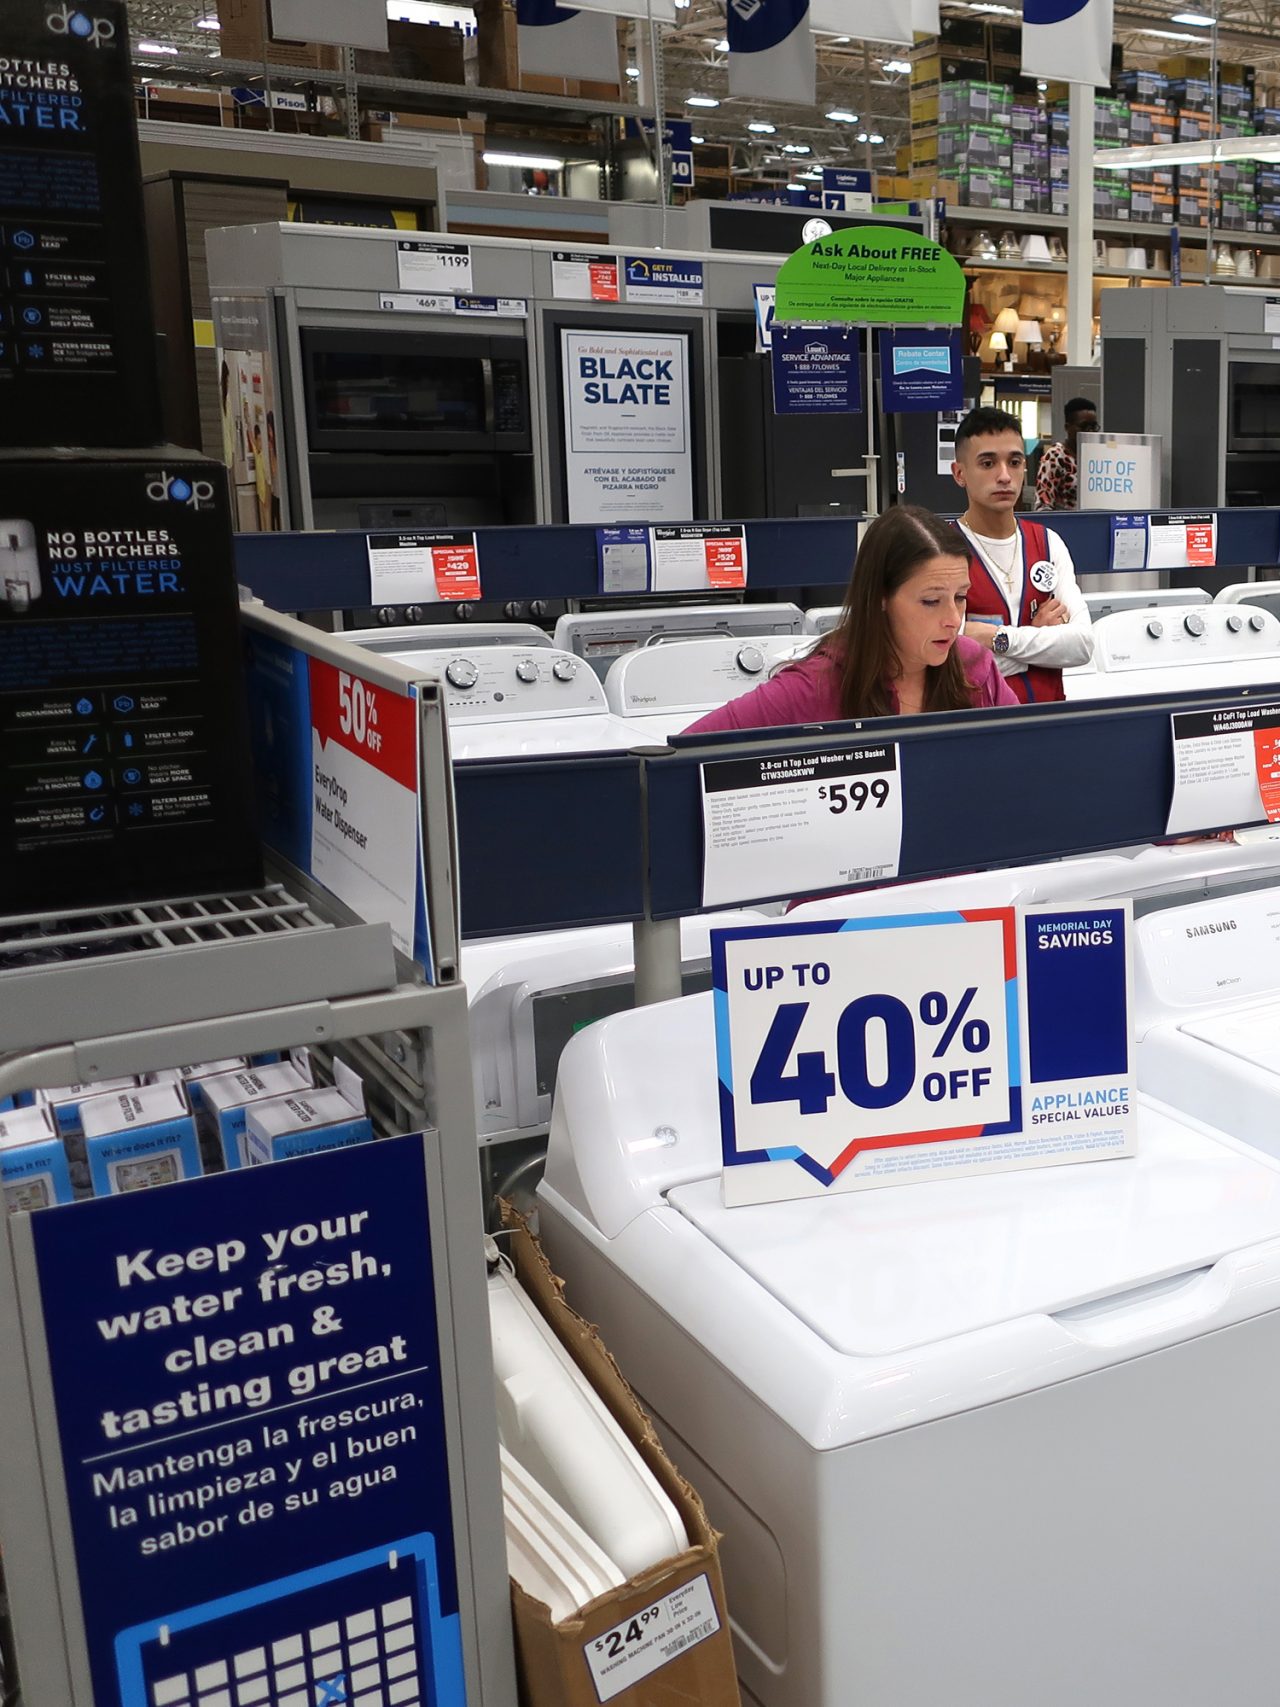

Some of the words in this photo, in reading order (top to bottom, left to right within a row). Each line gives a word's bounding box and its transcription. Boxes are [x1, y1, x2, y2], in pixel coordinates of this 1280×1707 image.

[1, 90, 82, 107] FILTERED
[277, 96, 306, 109] Pisos
[836, 175, 857, 183] Lighting
[811, 243, 844, 257] Ask
[847, 244, 897, 260] About
[901, 247, 941, 261] FREE
[812, 262, 846, 272] Next-Day
[847, 263, 867, 271] Local
[868, 263, 897, 273] Delivery
[652, 273, 702, 284] INSTALLED
[844, 273, 865, 283] Major
[866, 274, 904, 284] Appliances
[782, 354, 809, 362] SERVICE
[810, 354, 850, 362] ADVANTAGE
[898, 350, 922, 358] Rebate
[579, 356, 674, 381] BLACK
[584, 382, 671, 406] SLATE
[583, 466, 620, 475] ATRÉVASE
[627, 466, 676, 475] SOFISTÍQUESE
[1088, 459, 1112, 475] OUT
[1116, 461, 1137, 476] OF
[1088, 477, 1133, 493] ORDER
[47, 532, 76, 545] NO
[49, 546, 77, 559] NO
[52, 561, 92, 574] JUST
[101, 559, 181, 572] FILTERED
[53, 572, 186, 597] WATER.
[1247, 709, 1260, 718] Load
[1261, 707, 1280, 716] Washer
[367, 731, 382, 753] OFF
[789, 759, 802, 769] Top
[803, 757, 819, 766] Load
[820, 754, 844, 764] Washer
[865, 749, 886, 759] Basket
[315, 764, 348, 805] EveryDrop
[818, 778, 890, 815] $599
[315, 796, 334, 825] Water
[334, 810, 368, 850] Dispenser
[1037, 921, 1091, 934] MEMORIAL
[1092, 919, 1113, 931] DAY
[1186, 920, 1238, 939] SAMSUNG
[1038, 930, 1114, 950] SAVINGS
[743, 965, 784, 991] UP
[792, 962, 831, 988] TO
[750, 986, 991, 1116] 40%
[923, 1067, 992, 1102] OFF
[1031, 1087, 1130, 1112] APPLIANCE
[1031, 1110, 1081, 1125] SPECIAL
[1083, 1104, 1130, 1120] VALUES
[101, 1145, 132, 1157] Where
[134, 1140, 156, 1151] does
[116, 1239, 246, 1287] Keep
[261, 1210, 368, 1261] your
[97, 1287, 242, 1340] water
[258, 1250, 391, 1302] fresh,
[164, 1323, 294, 1373] clean
[311, 1305, 343, 1336] &
[101, 1375, 271, 1439] tasting
[288, 1335, 407, 1396] great
[93, 1437, 252, 1497] Mantenga
[263, 1426, 289, 1449] la
[297, 1392, 424, 1438] frescura,
[110, 1505, 137, 1528] la
[149, 1466, 277, 1518] limpieza
[286, 1458, 302, 1482] y
[311, 1442, 337, 1469] el
[348, 1425, 416, 1458] buen
[140, 1513, 229, 1556] sabor
[238, 1500, 275, 1526] de
[285, 1489, 319, 1511] su
[329, 1464, 398, 1498] agua
[669, 1585, 694, 1604] Everyday
[671, 1600, 683, 1611] Low
[673, 1606, 688, 1618] Price
[600, 1657, 627, 1676] WASHING
[628, 1641, 653, 1661] MACHINE
